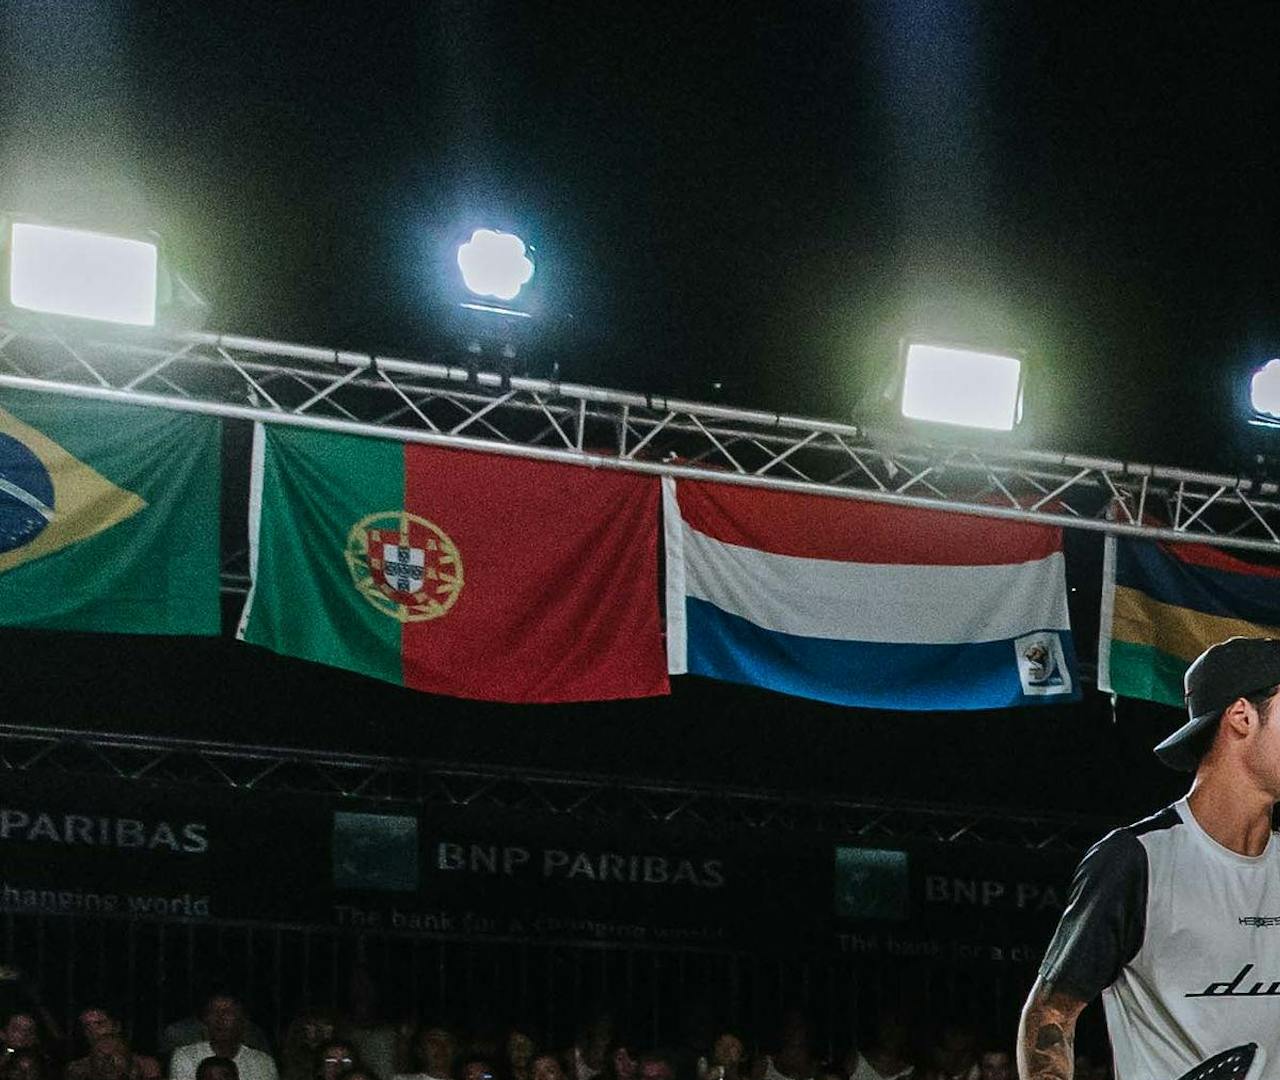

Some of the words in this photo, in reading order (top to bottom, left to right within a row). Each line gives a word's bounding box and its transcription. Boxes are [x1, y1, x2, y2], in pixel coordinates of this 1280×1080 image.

[0, 809, 208, 851] PARIBAS
[438, 841, 531, 876] BNP
[542, 848, 726, 888] PARIBAS
[924, 875, 1004, 906] BNP
